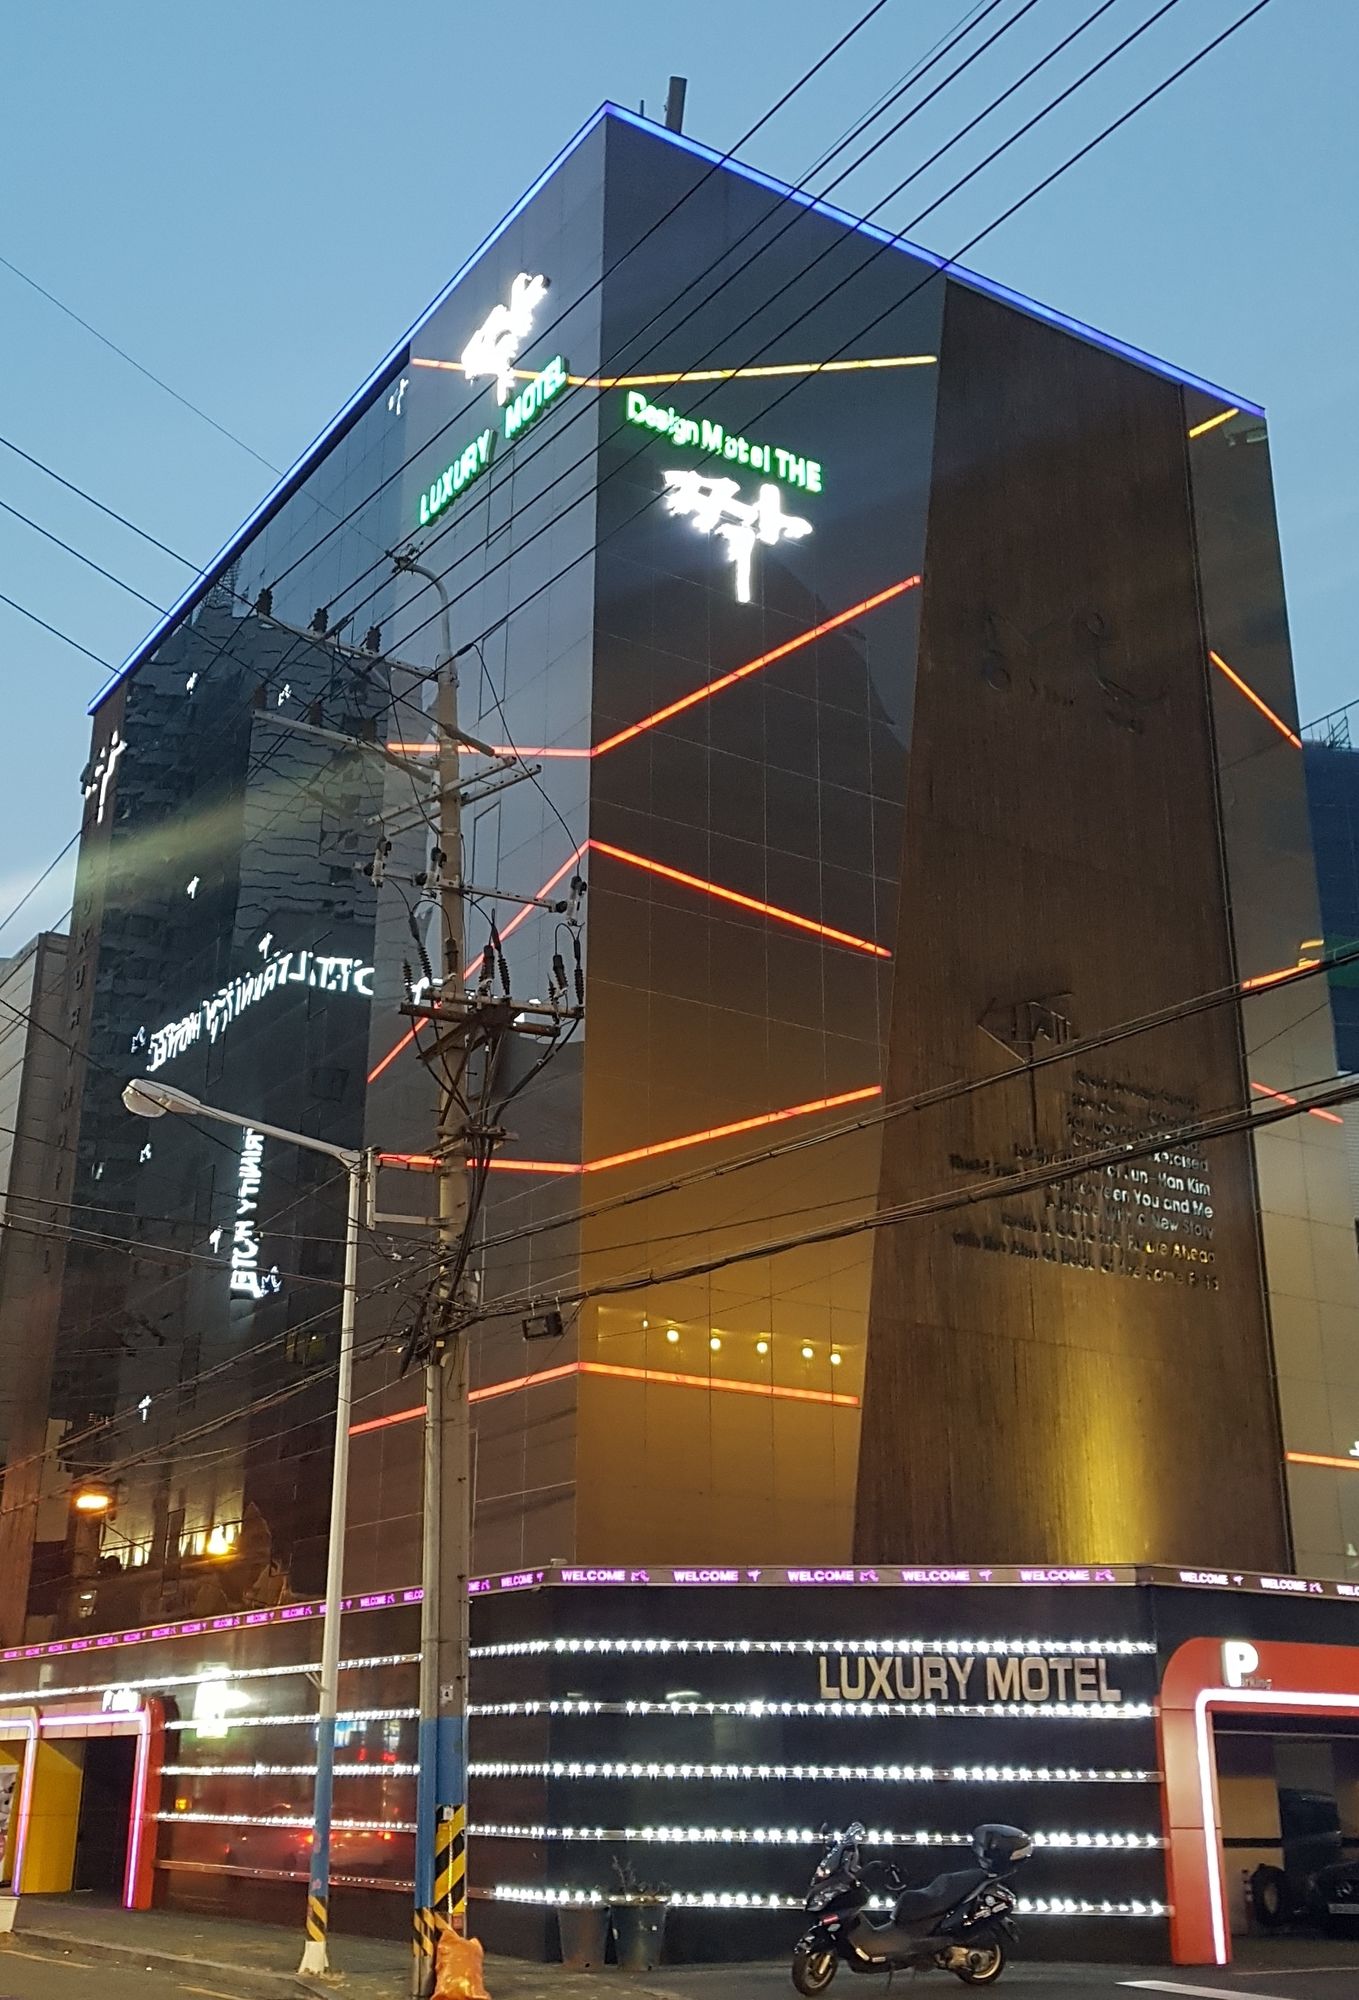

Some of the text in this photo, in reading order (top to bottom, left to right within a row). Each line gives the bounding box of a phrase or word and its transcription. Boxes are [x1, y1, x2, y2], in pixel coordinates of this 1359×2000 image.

[420, 355, 567, 525] LUXURY MOTEL
[626, 390, 821, 492] Design Motel THE
[1133, 1189, 1160, 1209] You
[1163, 1198, 1189, 1214] and
[501, 1574, 533, 1587] WELCOME
[561, 1570, 1090, 1582] WELCOME WELCOME WELCOME WELCOME WELCOME
[1180, 1572, 1229, 1586] WELCOME
[1260, 1578, 1307, 1592] WELCOME
[819, 1656, 1122, 1701] LUXURY MOTEL
